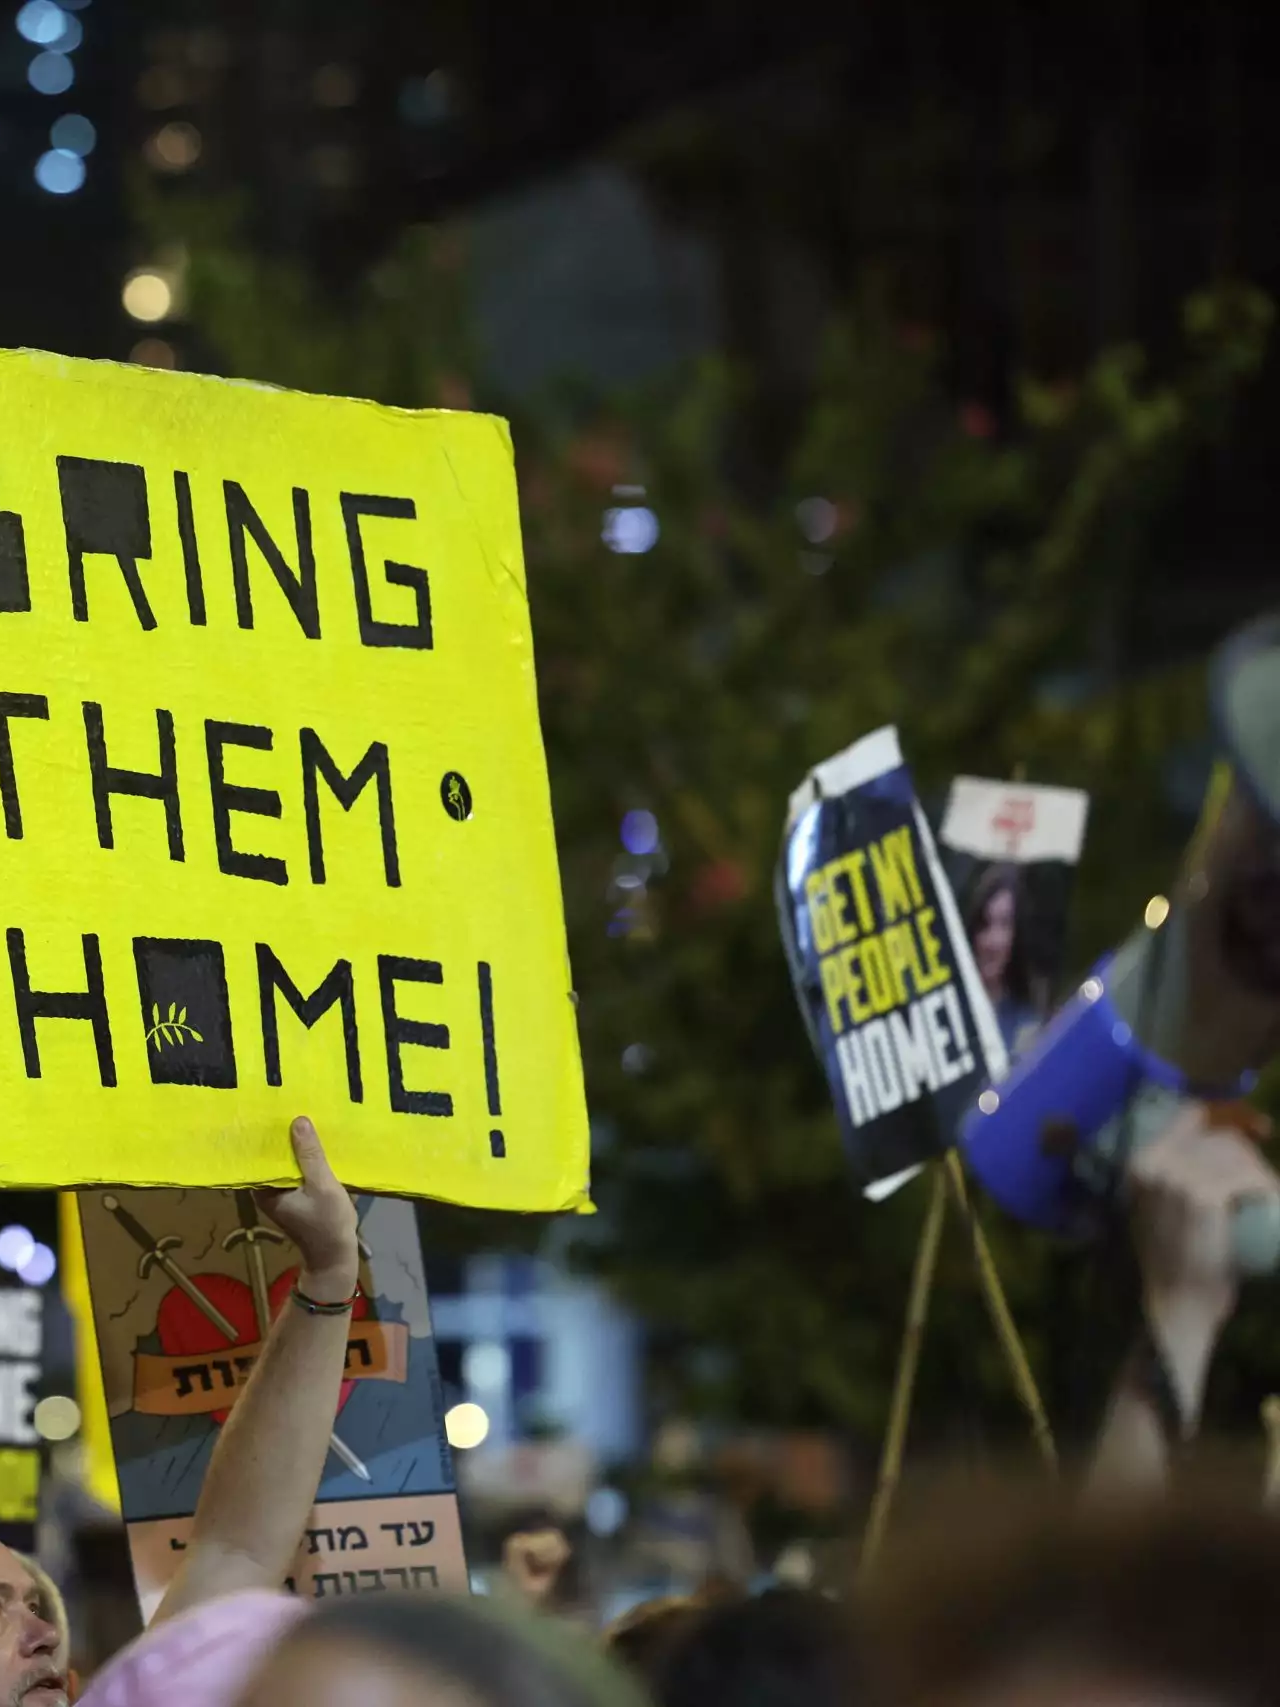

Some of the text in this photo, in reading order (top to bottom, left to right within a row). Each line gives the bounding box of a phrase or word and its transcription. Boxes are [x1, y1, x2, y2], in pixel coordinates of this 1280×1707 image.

[804, 825, 924, 954] GET MY
[818, 905, 952, 1035] PEOPLE
[5, 927, 508, 1159] HOME!
[836, 984, 976, 1128] HOME!
[302, 1520, 435, 1554] עד מת
